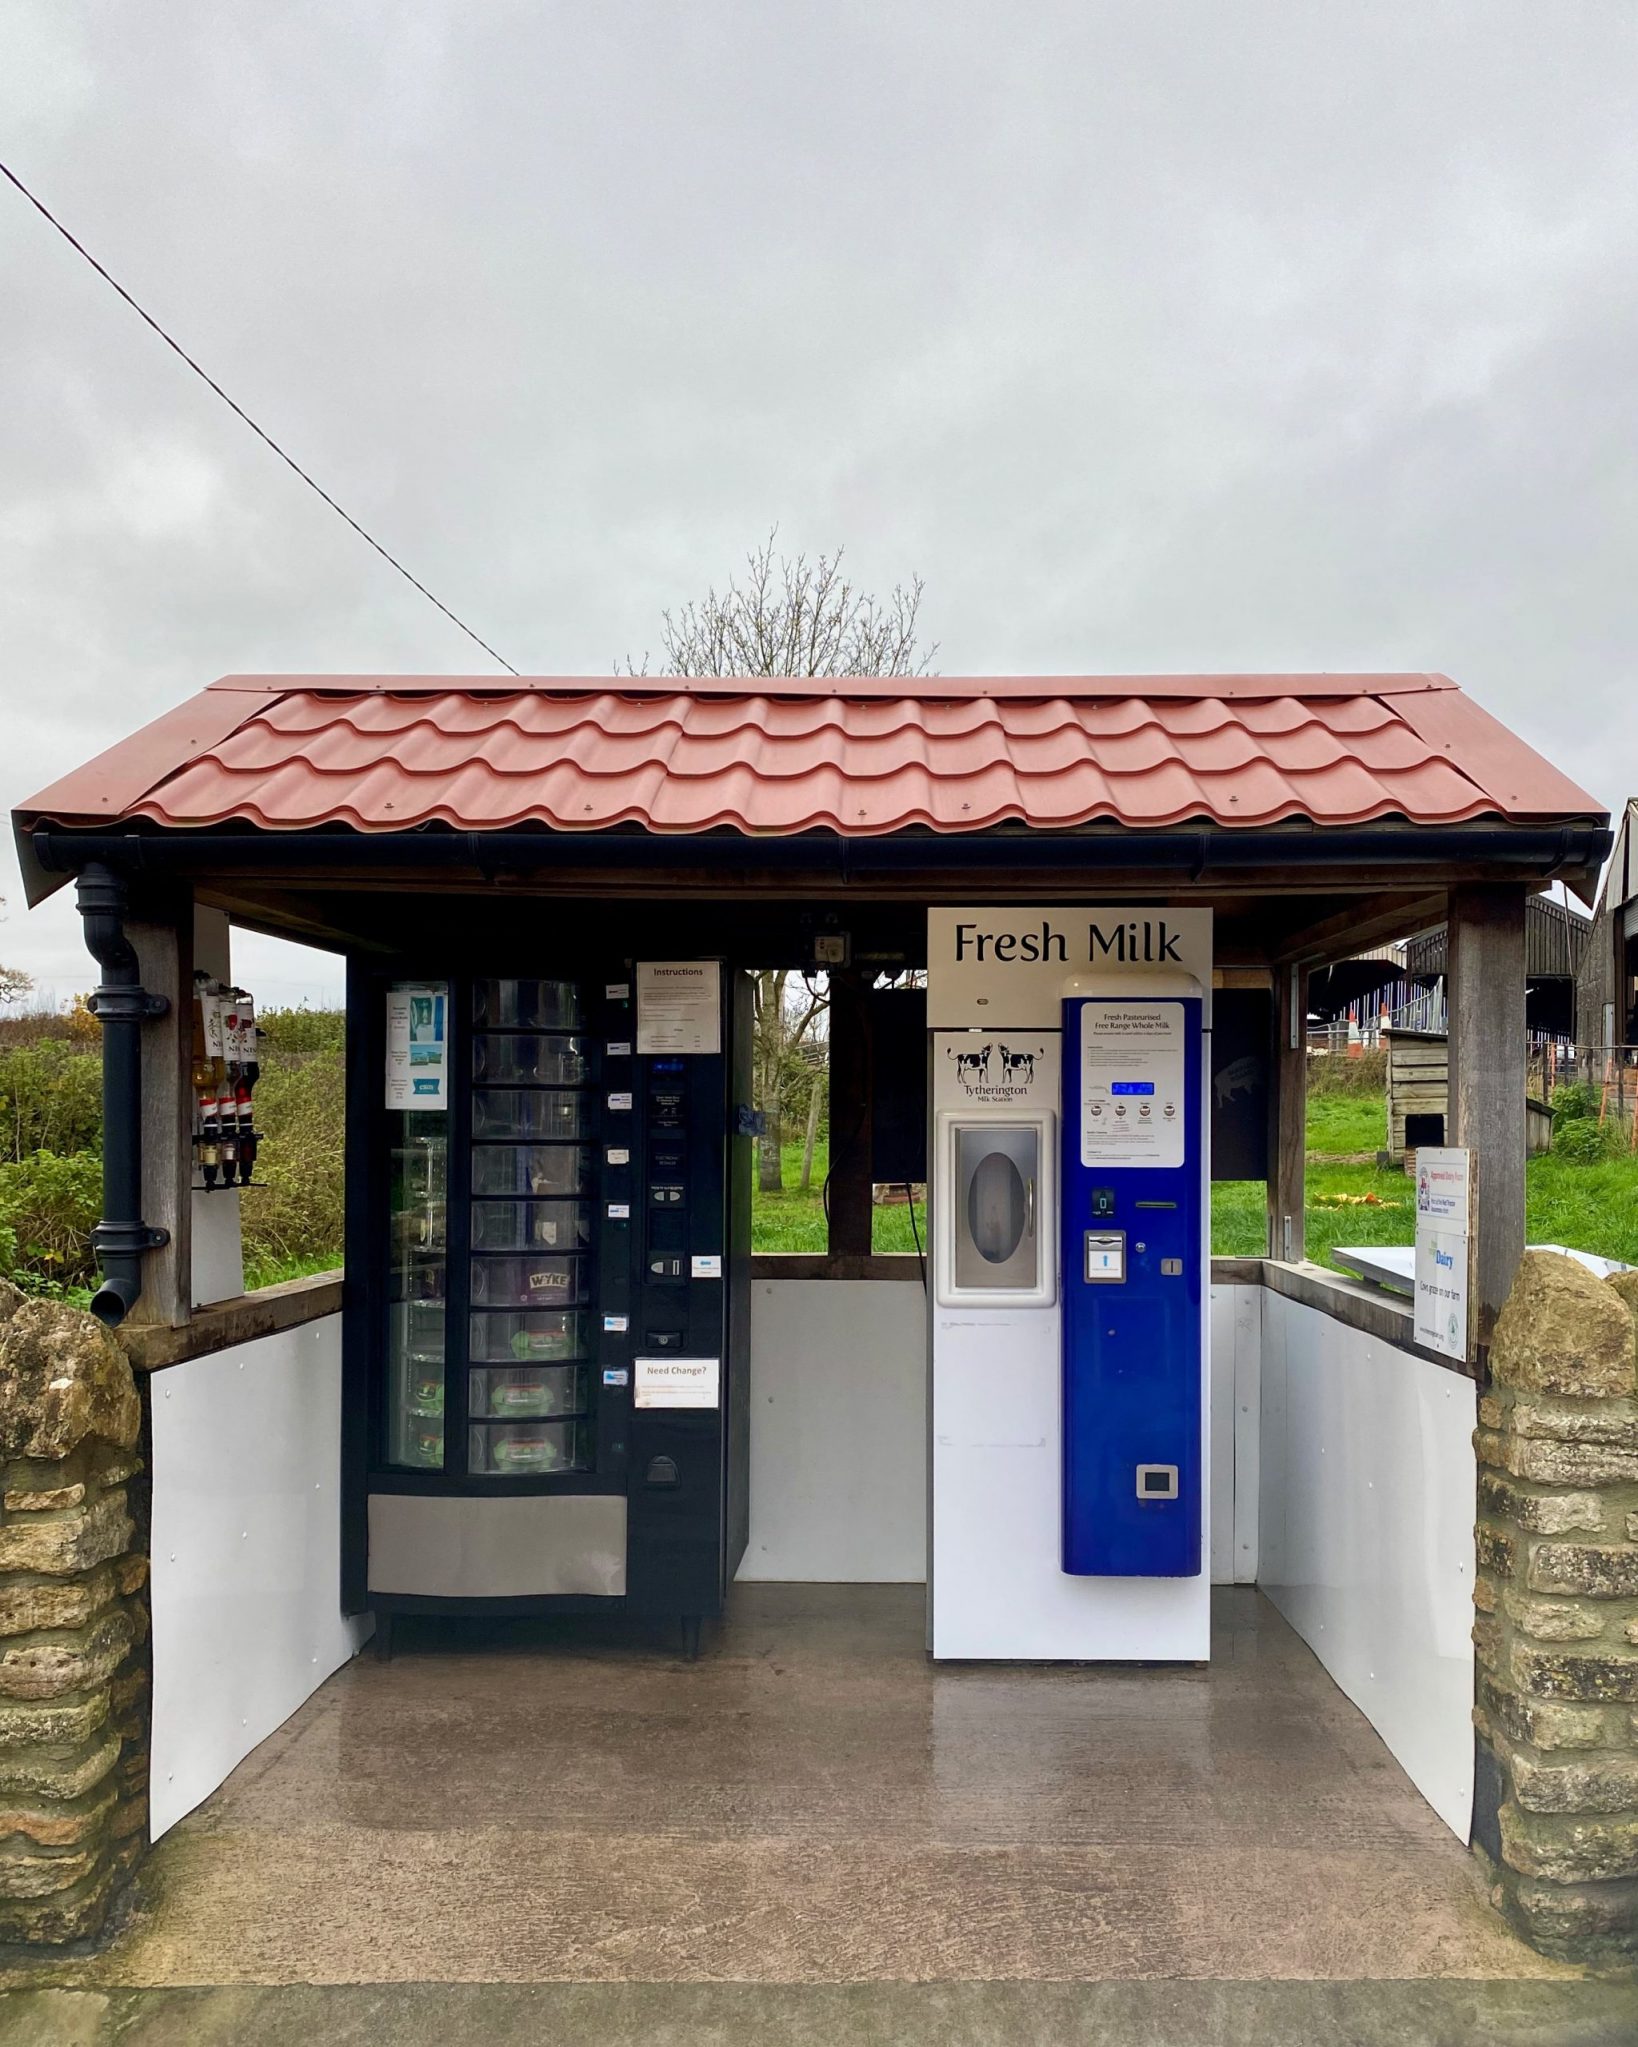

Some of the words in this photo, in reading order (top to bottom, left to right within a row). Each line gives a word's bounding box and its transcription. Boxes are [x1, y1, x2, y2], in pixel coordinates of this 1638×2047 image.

[955, 921, 1069, 963] Fresh
[1089, 921, 1183, 963] Milk
[653, 967, 704, 976] Instructions
[1104, 1013, 1121, 1021] Fresh
[1123, 1013, 1161, 1021] Pasteurised
[1110, 1022, 1131, 1031] Range
[963, 1084, 1028, 1097] Tytherington
[1436, 1249, 1454, 1270] Dairy
[531, 1273, 567, 1286] WYKE
[647, 1366, 669, 1375] Need
[671, 1366, 707, 1376] Change?
